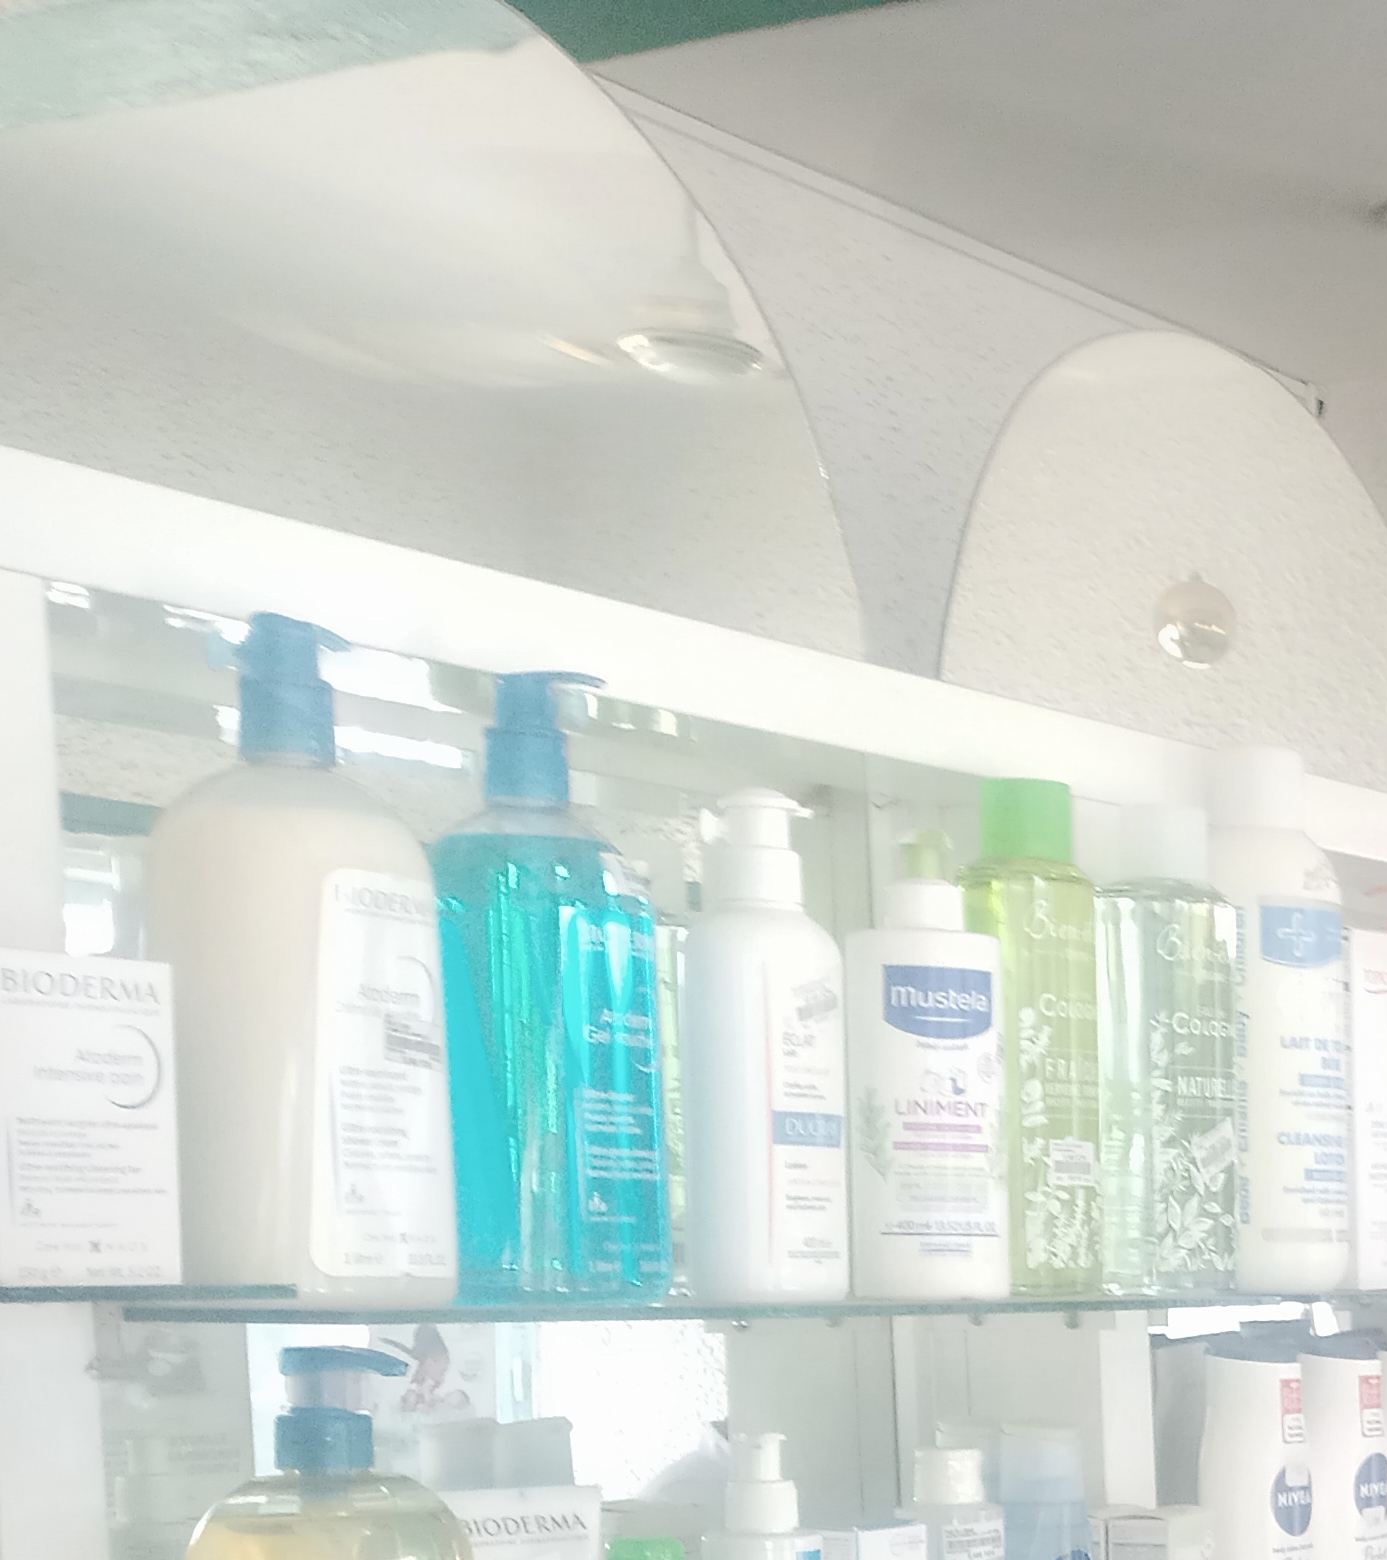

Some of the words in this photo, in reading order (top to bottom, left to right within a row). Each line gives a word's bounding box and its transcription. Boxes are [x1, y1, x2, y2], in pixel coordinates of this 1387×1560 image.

[1, 967, 161, 1005] BIODERMA
[891, 986, 989, 1011] mustela
[895, 1099, 988, 1119] LINIMENT
